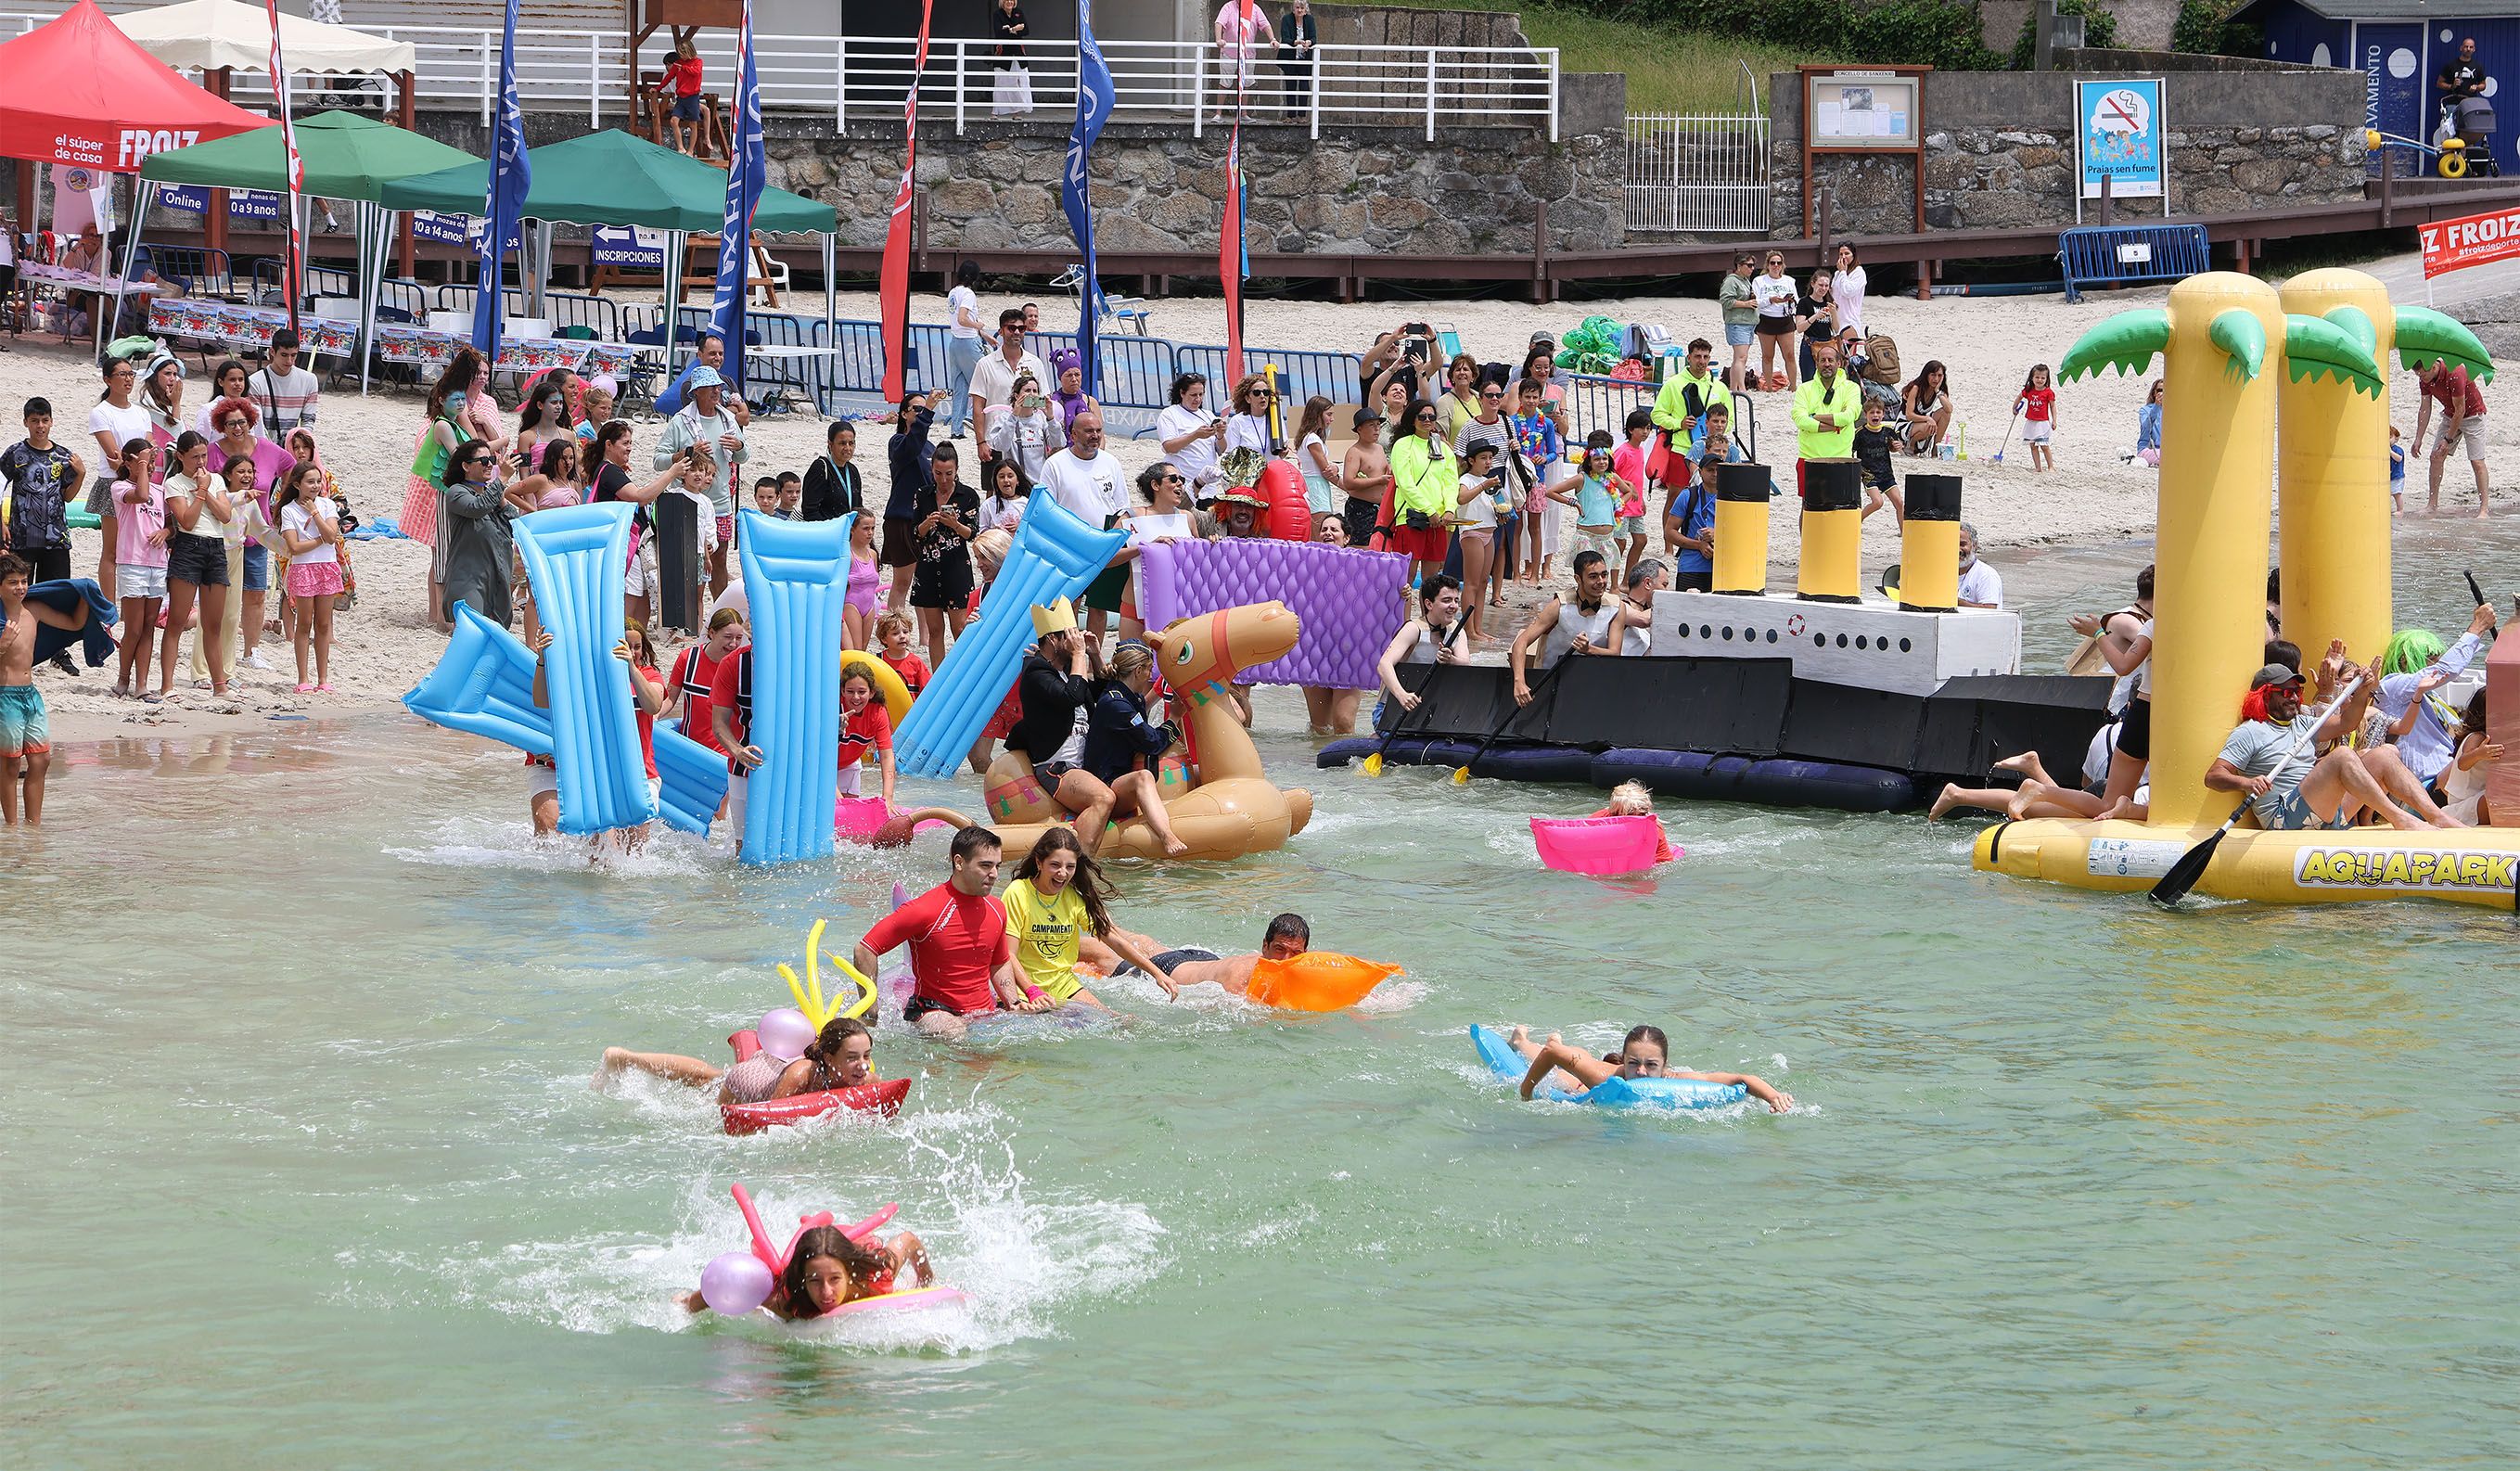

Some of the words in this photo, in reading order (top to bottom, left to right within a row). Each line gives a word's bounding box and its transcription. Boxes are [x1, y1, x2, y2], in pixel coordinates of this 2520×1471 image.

[2366, 45, 2381, 131] LVAMENTO
[55, 134, 66, 147] el
[69, 136, 104, 152] súper
[54, 147, 70, 160] de
[73, 151, 104, 164] casa
[2087, 164, 2114, 174] Praias
[2132, 163, 2156, 173] fume
[165, 191, 202, 210] Online
[269, 193, 277, 201] de
[231, 201, 238, 213] 0
[238, 204, 245, 213] a
[246, 202, 252, 214] 9
[253, 205, 277, 216] anos
[436, 216, 456, 226] mozas
[457, 219, 466, 228] de
[414, 220, 424, 233] 10
[424, 225, 430, 235] a
[431, 224, 442, 237] 14
[441, 228, 464, 243] anos
[2458, 238, 2520, 256] #froizdeporte
[595, 249, 661, 264] INSCRIPCIONES
[1103, 481, 1113, 493] 39
[2300, 850, 2518, 889] AQUAPARK
